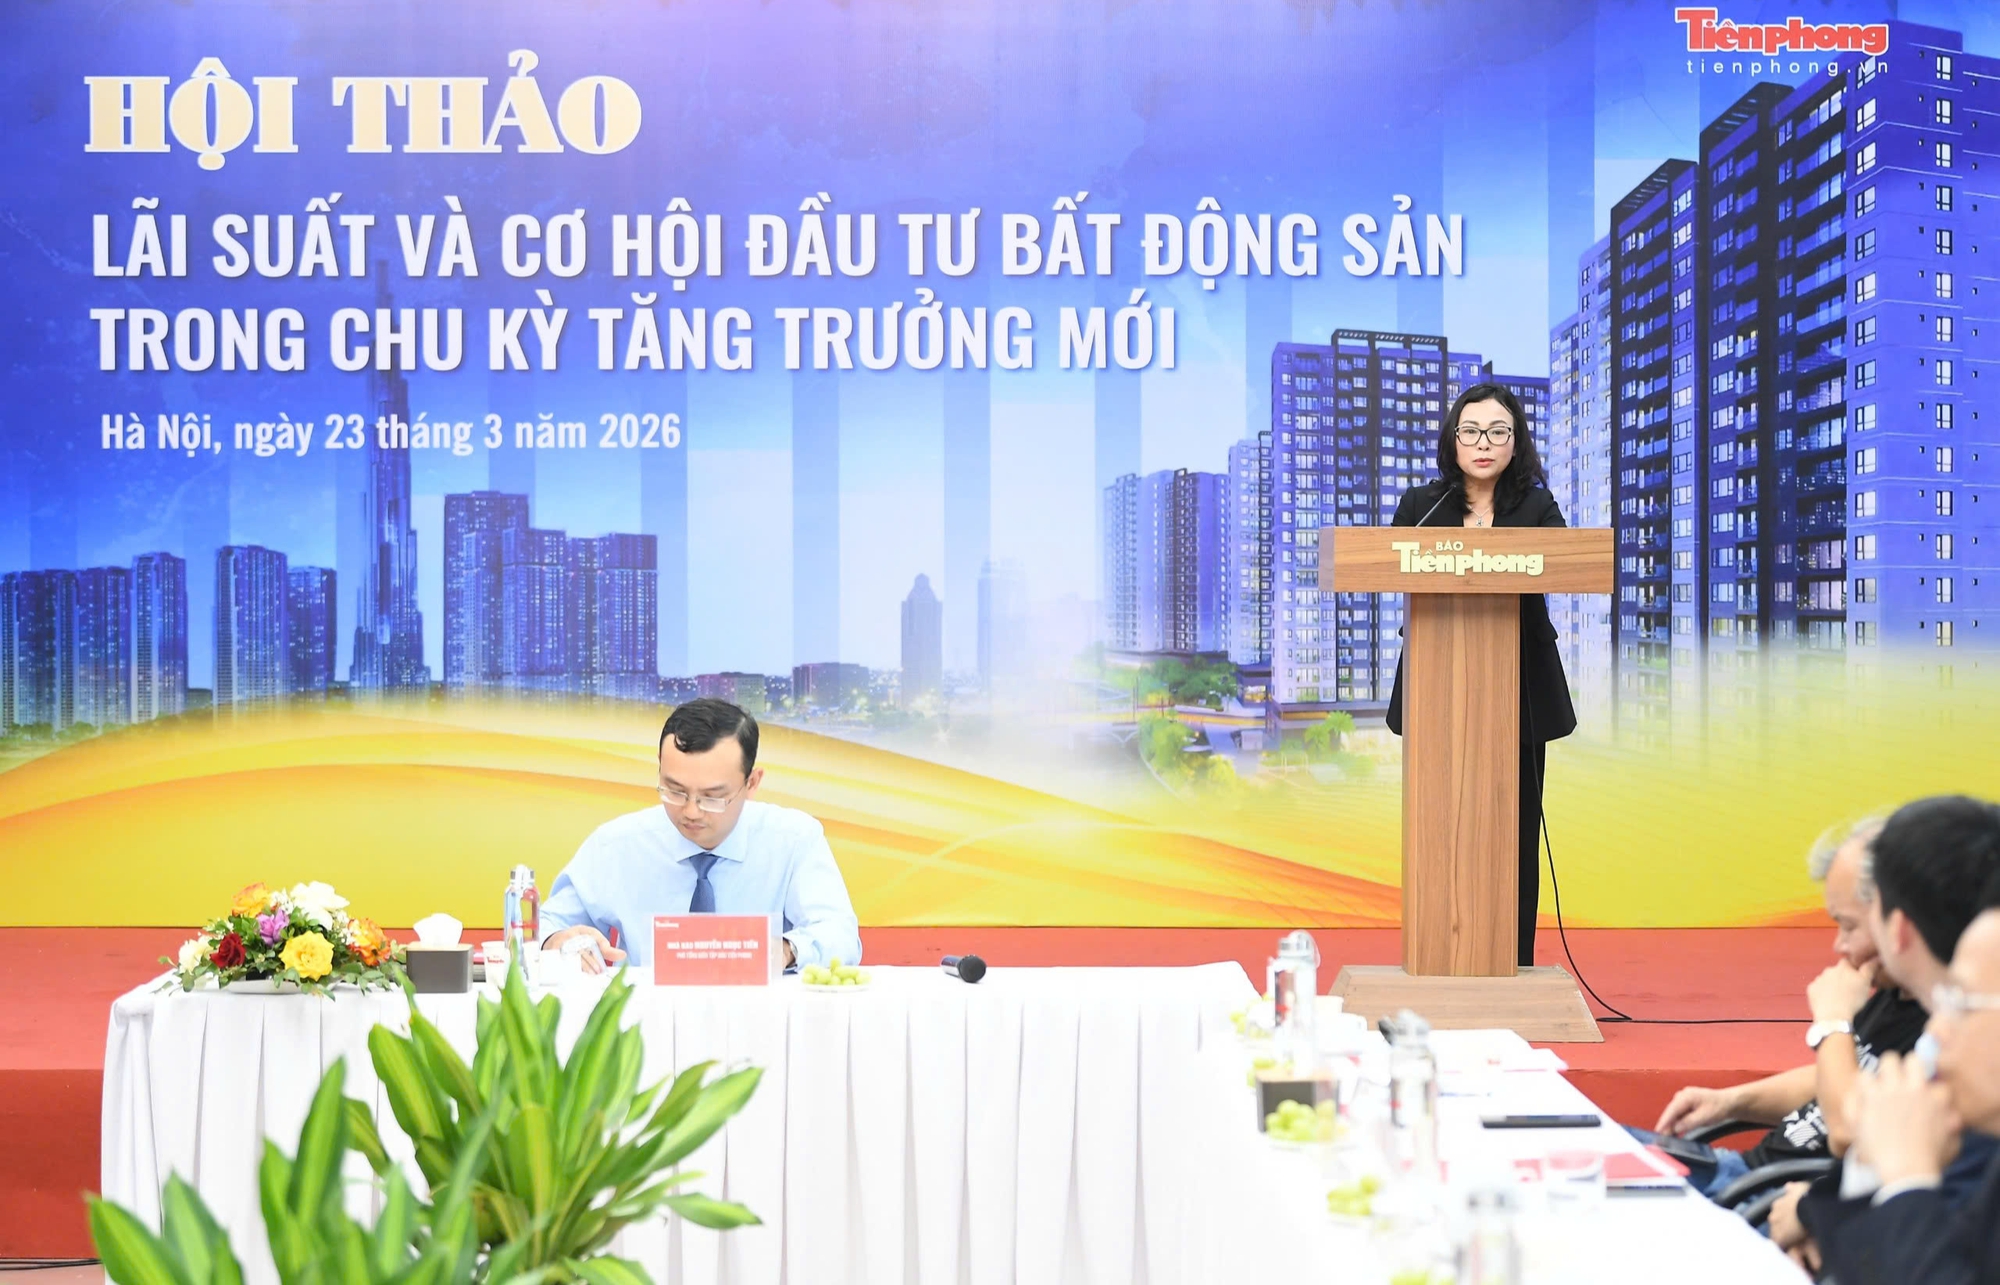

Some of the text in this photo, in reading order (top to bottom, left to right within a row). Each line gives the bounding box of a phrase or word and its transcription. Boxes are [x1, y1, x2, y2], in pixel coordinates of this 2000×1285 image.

[1686, 59, 1888, 76] tienphong.vn
[84, 49, 642, 170] HỘI THẢO
[93, 192, 1464, 291] LÃI SUẤT VÀ CƠ HỘI ĐẦU TƯ BẤT ĐỘNG SẢN
[91, 288, 1176, 371] TRONG CHU KỲ TĂNG TRƯỞNG MỚI
[102, 413, 681, 457] Hà Nội, ngày 23 tháng 3 năm 2026
